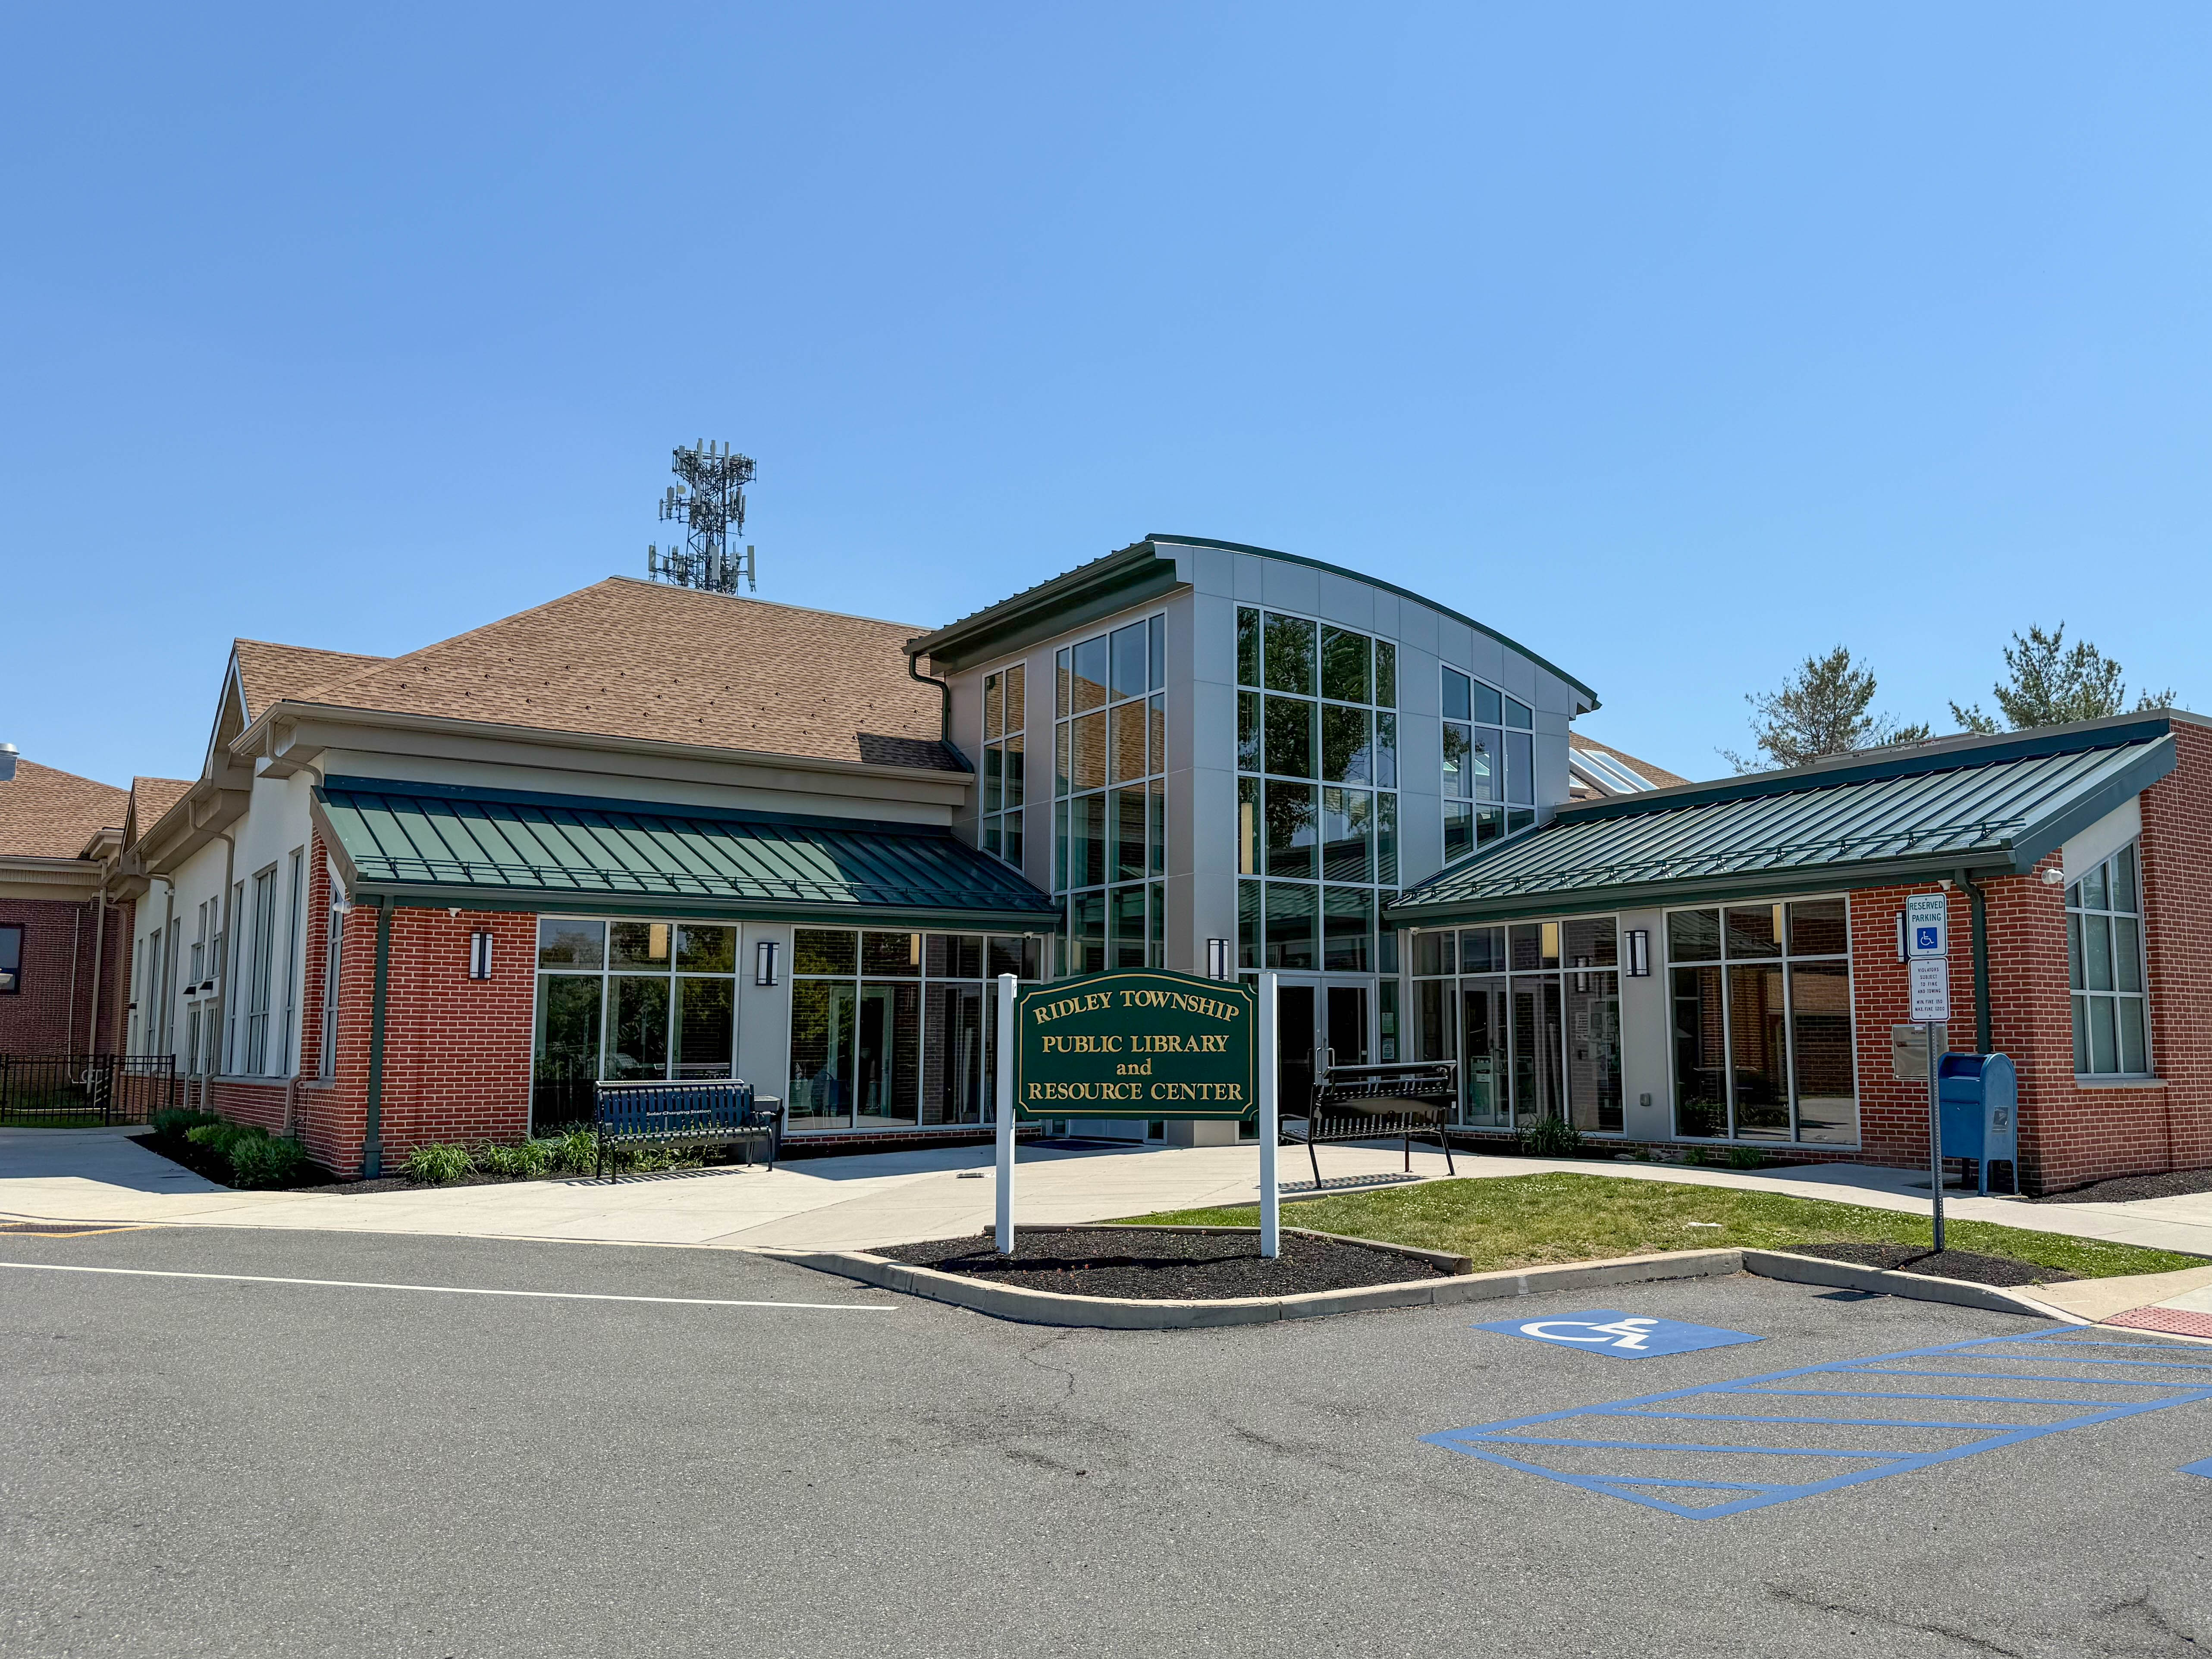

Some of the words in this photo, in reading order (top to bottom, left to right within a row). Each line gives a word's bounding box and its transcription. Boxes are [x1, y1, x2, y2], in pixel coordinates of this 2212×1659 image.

[1910, 901, 1943, 910] RESERVED
[1912, 913, 1941, 922] PARKING
[1032, 992, 1112, 1024] RIDLEY
[1120, 990, 1239, 1022] TOWNSHIP
[1042, 1036, 1122, 1053] PUBLIC
[1130, 1035, 1229, 1053] LIBRARY
[1117, 1058, 1152, 1075] and
[1028, 1083, 1142, 1100] RESOURCE
[1151, 1083, 1243, 1100] CENTER
